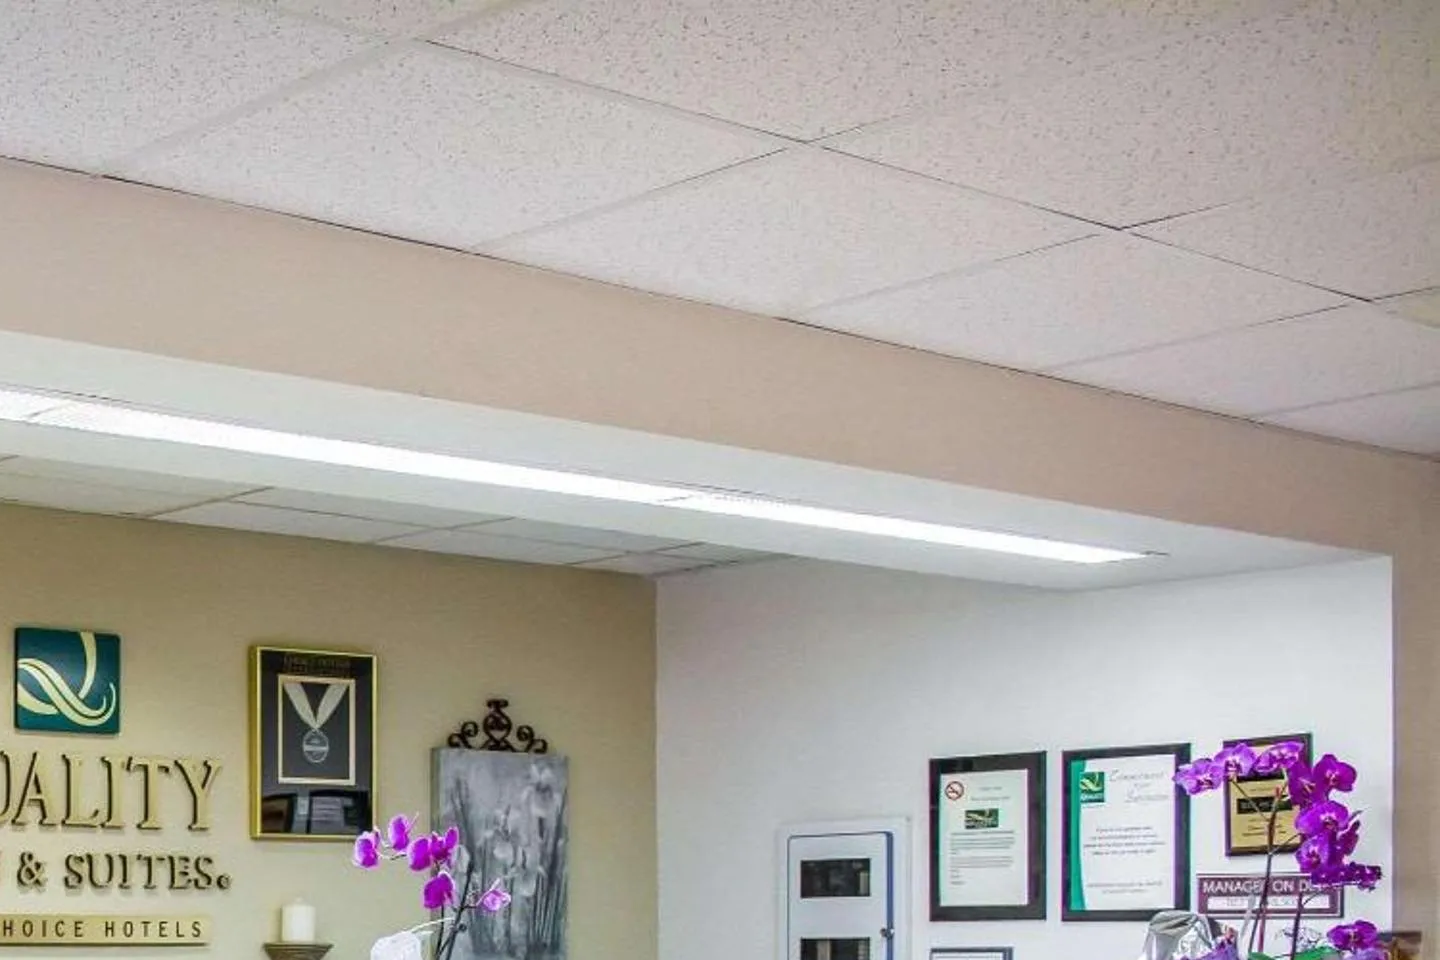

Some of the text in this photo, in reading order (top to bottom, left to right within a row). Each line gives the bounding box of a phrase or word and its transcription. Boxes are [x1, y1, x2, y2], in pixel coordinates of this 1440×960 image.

[16, 851, 48, 888] &
[1202, 880, 1266, 895] MANAGE
[1272, 880, 1294, 893] ON
[104, 919, 202, 939] HOTELS
